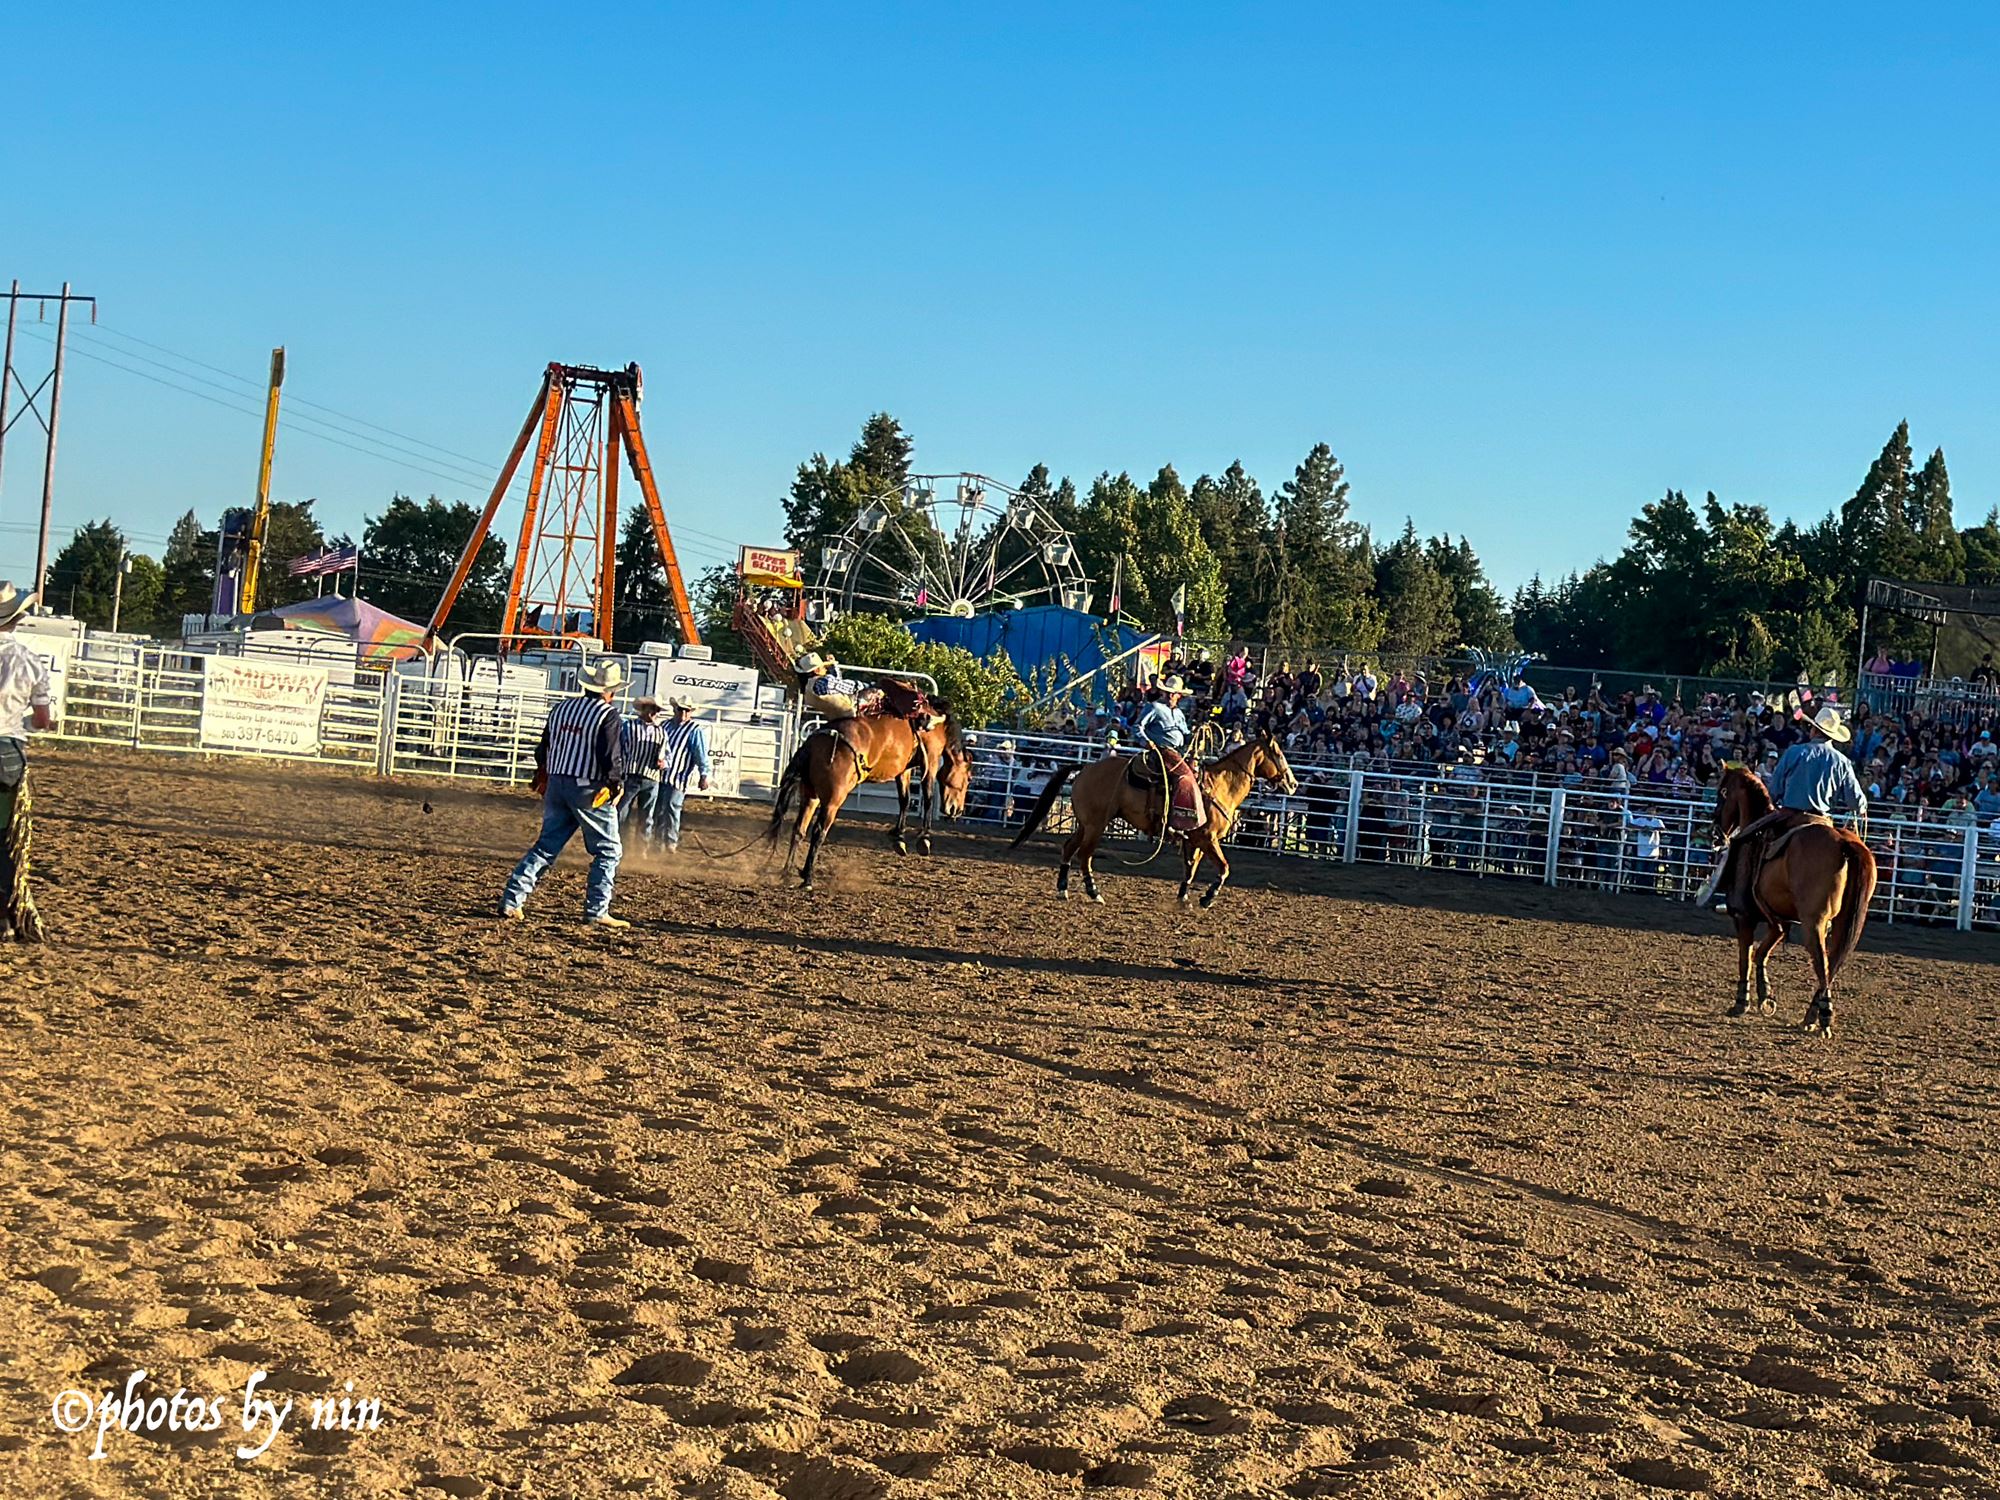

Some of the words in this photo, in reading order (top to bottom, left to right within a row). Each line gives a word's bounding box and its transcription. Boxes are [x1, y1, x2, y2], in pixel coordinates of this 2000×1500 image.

[751, 552, 787, 566] SUPER
[752, 560, 786, 575] SLIDE
[232, 667, 325, 695] MIDWAY
[673, 675, 739, 691] CAYENNE
[237, 726, 299, 745] 397-6470
[707, 749, 737, 759] OCAL
